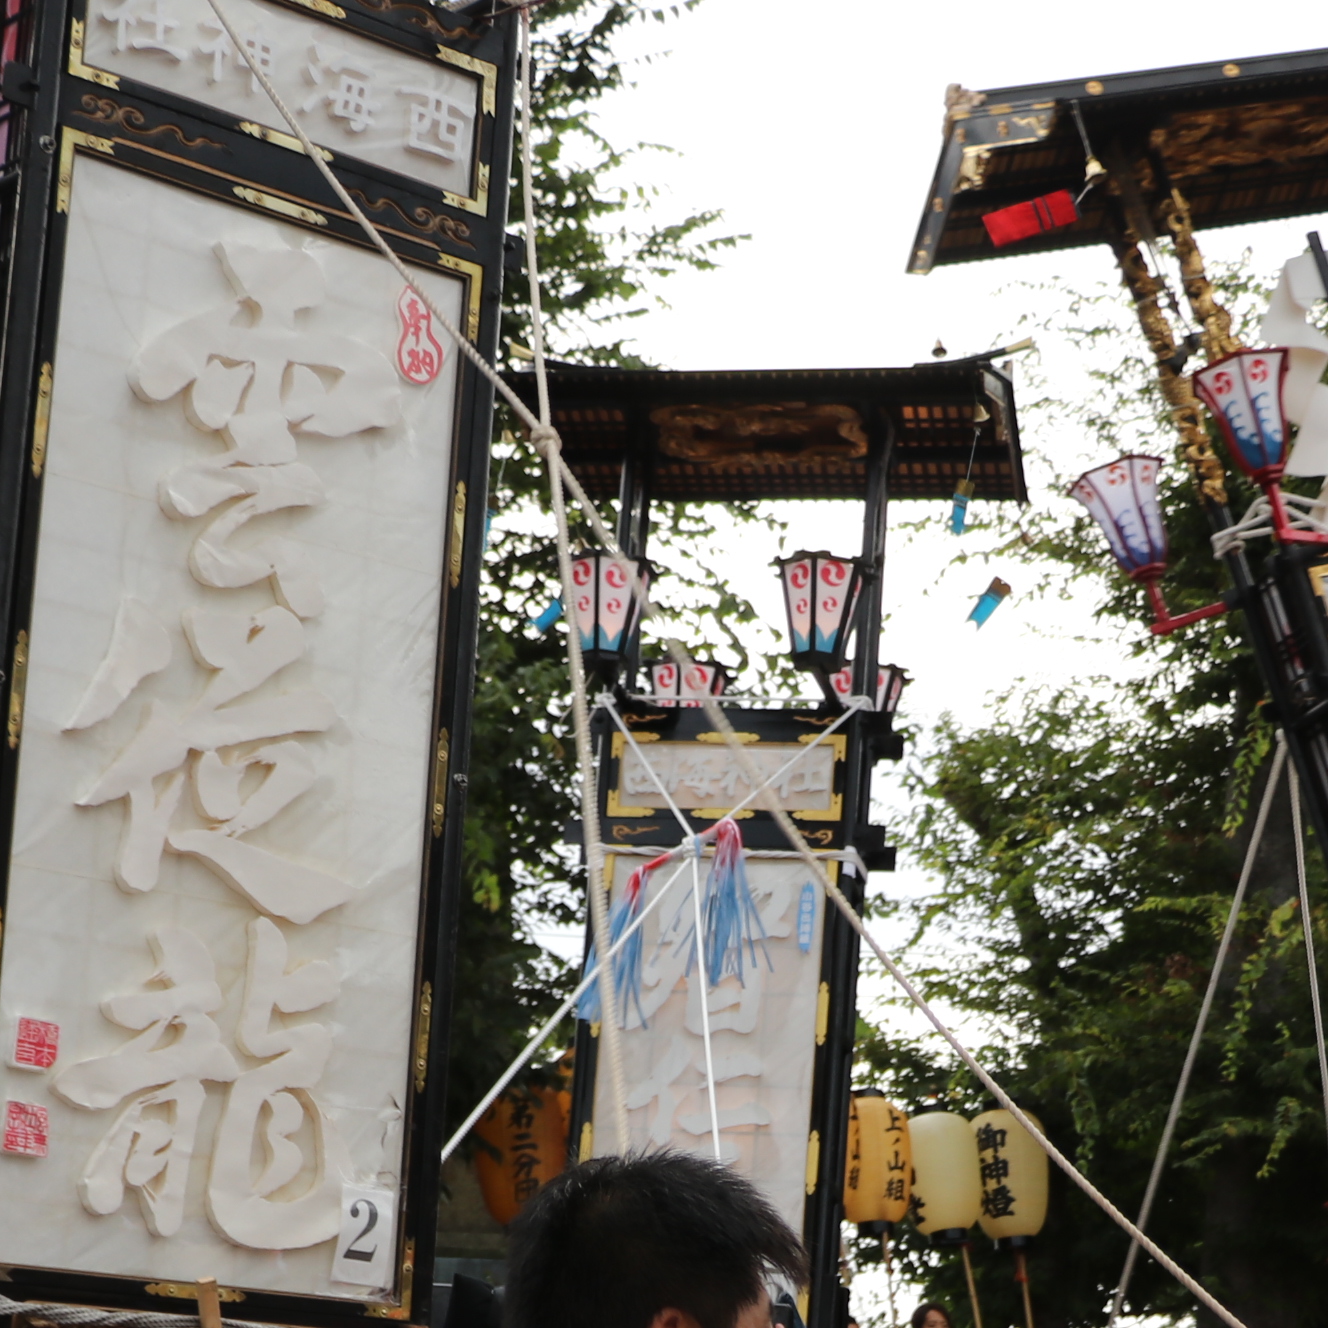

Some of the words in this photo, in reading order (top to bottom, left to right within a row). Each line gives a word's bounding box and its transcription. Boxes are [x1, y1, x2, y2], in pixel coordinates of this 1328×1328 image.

[102, 1, 476, 164] 西海神社
[974, 1121, 1017, 1220] 御神燈
[343, 1198, 378, 1262] 2
